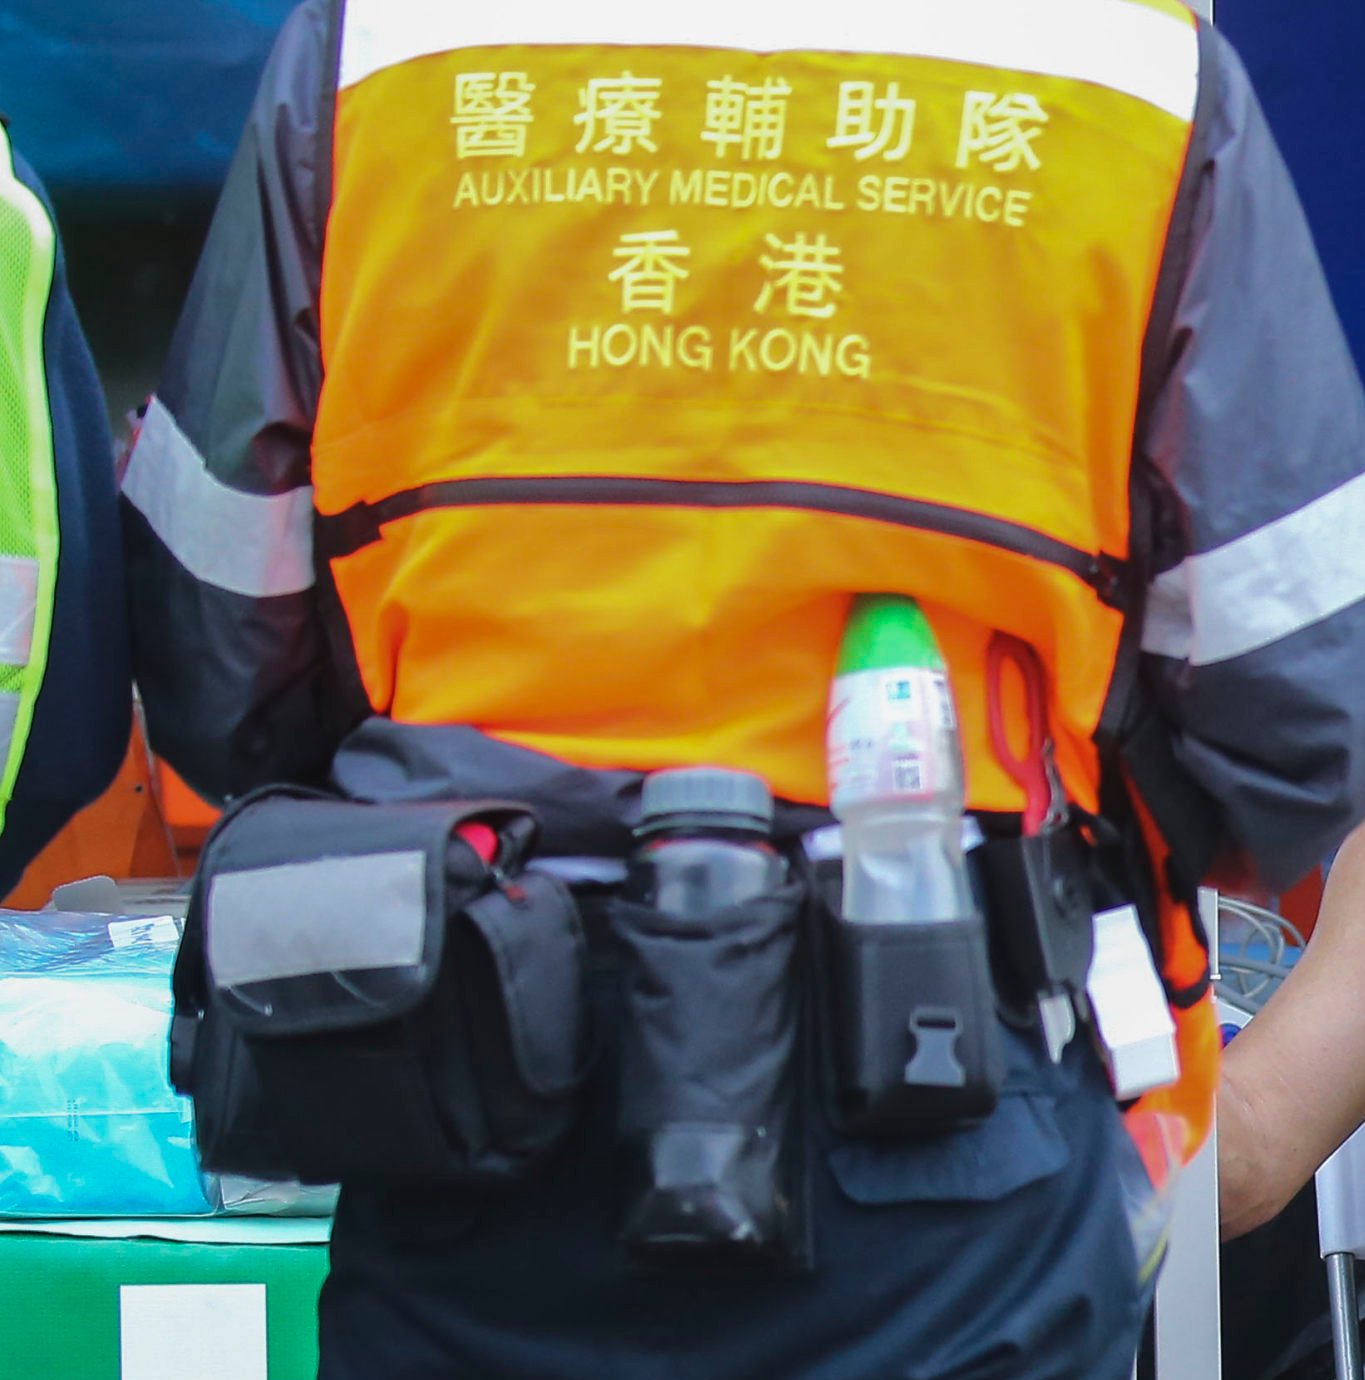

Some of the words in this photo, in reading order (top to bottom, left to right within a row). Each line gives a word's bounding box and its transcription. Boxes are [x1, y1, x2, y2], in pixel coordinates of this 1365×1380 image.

[450, 70, 1049, 173] 醫療輔助隊
[453, 168, 661, 210] AUXILIARY
[668, 170, 845, 212] MEDICAL
[856, 176, 1033, 228] SERVICE
[607, 227, 846, 319] 香港
[568, 324, 714, 372] HONG
[728, 328, 872, 379] KONG
